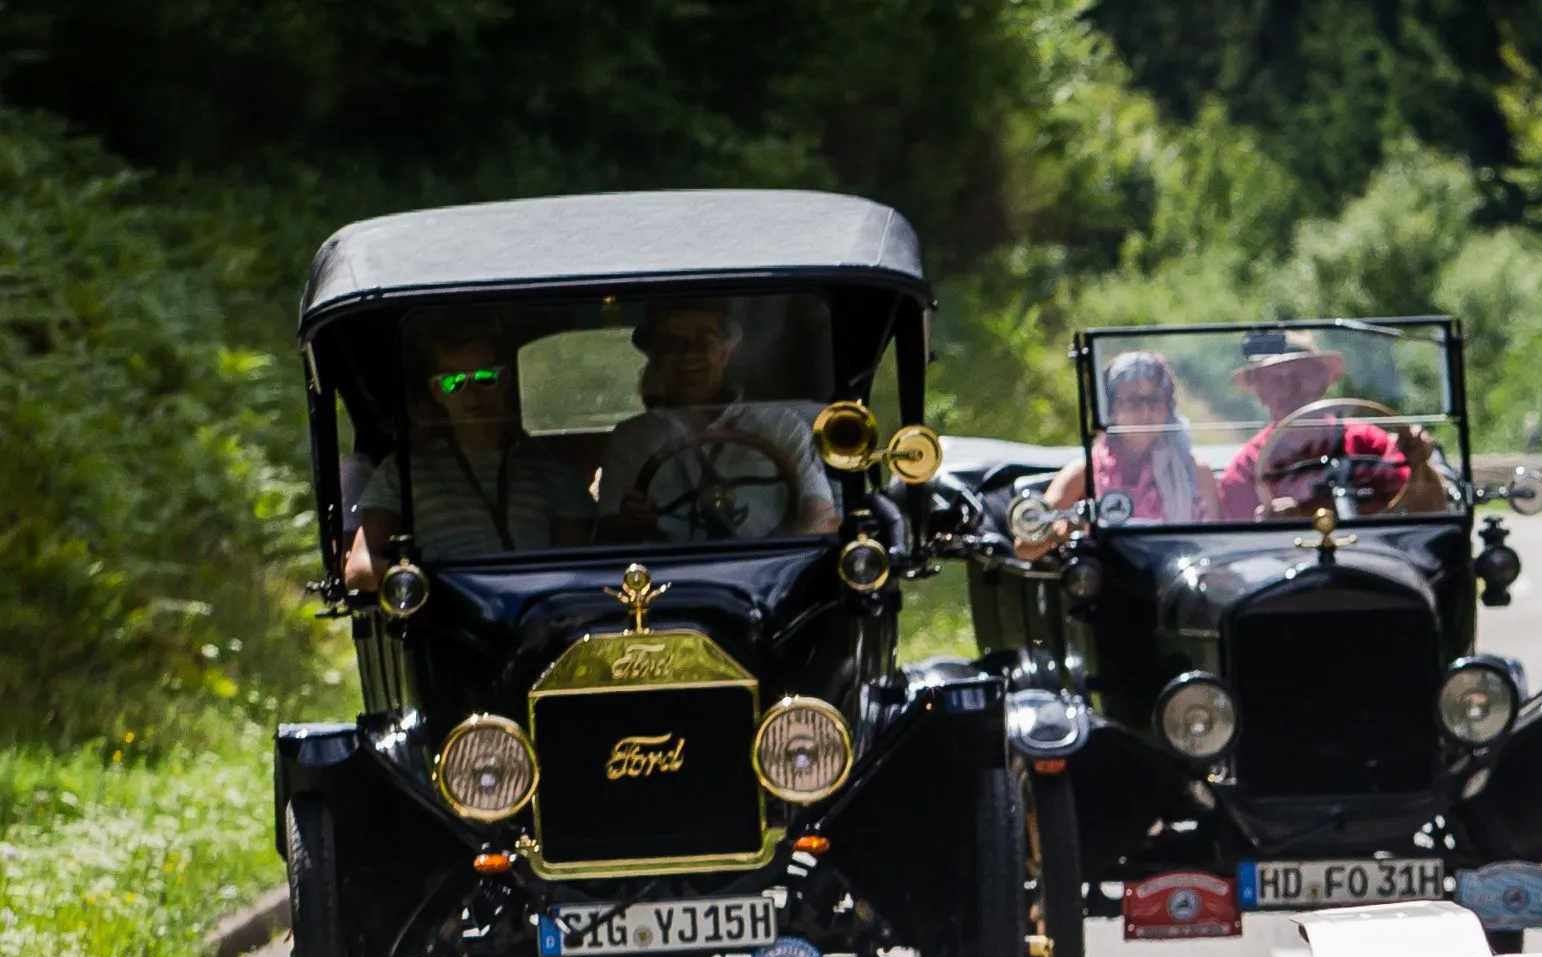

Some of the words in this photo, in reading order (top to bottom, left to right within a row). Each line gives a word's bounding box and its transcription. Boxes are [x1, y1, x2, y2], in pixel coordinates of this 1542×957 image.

[612, 643, 675, 680] Ford
[605, 731, 686, 780] Ford
[1259, 867, 1302, 898] HD
